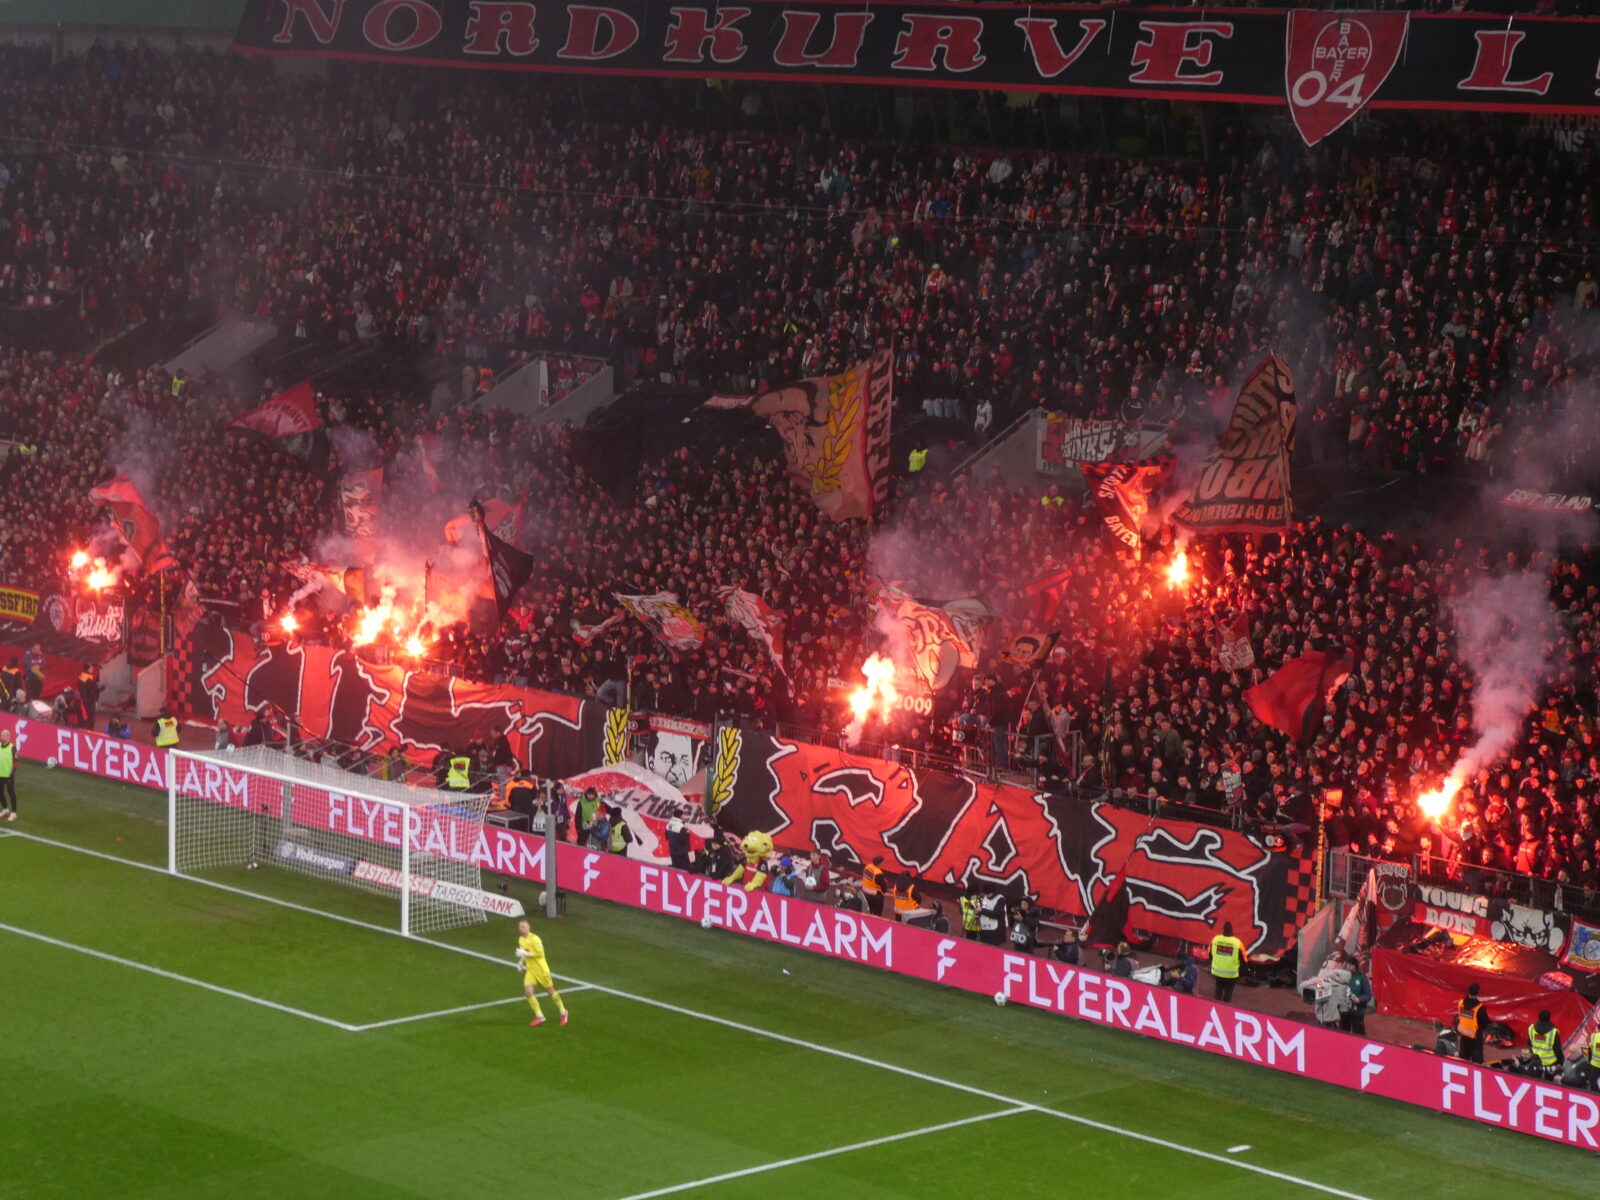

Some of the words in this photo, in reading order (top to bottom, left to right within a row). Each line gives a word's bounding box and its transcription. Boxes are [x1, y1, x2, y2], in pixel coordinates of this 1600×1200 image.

[272, 0, 1235, 87] NORDKURVE
[1314, 46, 1369, 60] BAYER
[1292, 69, 1366, 109] 04
[894, 694, 933, 716] 2009
[296, 846, 346, 870] Volkswagen
[57, 729, 249, 808] FLYERALARM
[328, 791, 547, 883] FLYERALARM
[640, 866, 893, 968] FLYERALARM
[1003, 954, 1306, 1073] FLYERALARM
[1418, 885, 1489, 918] YOUNG
[1425, 907, 1477, 936] BOYS
